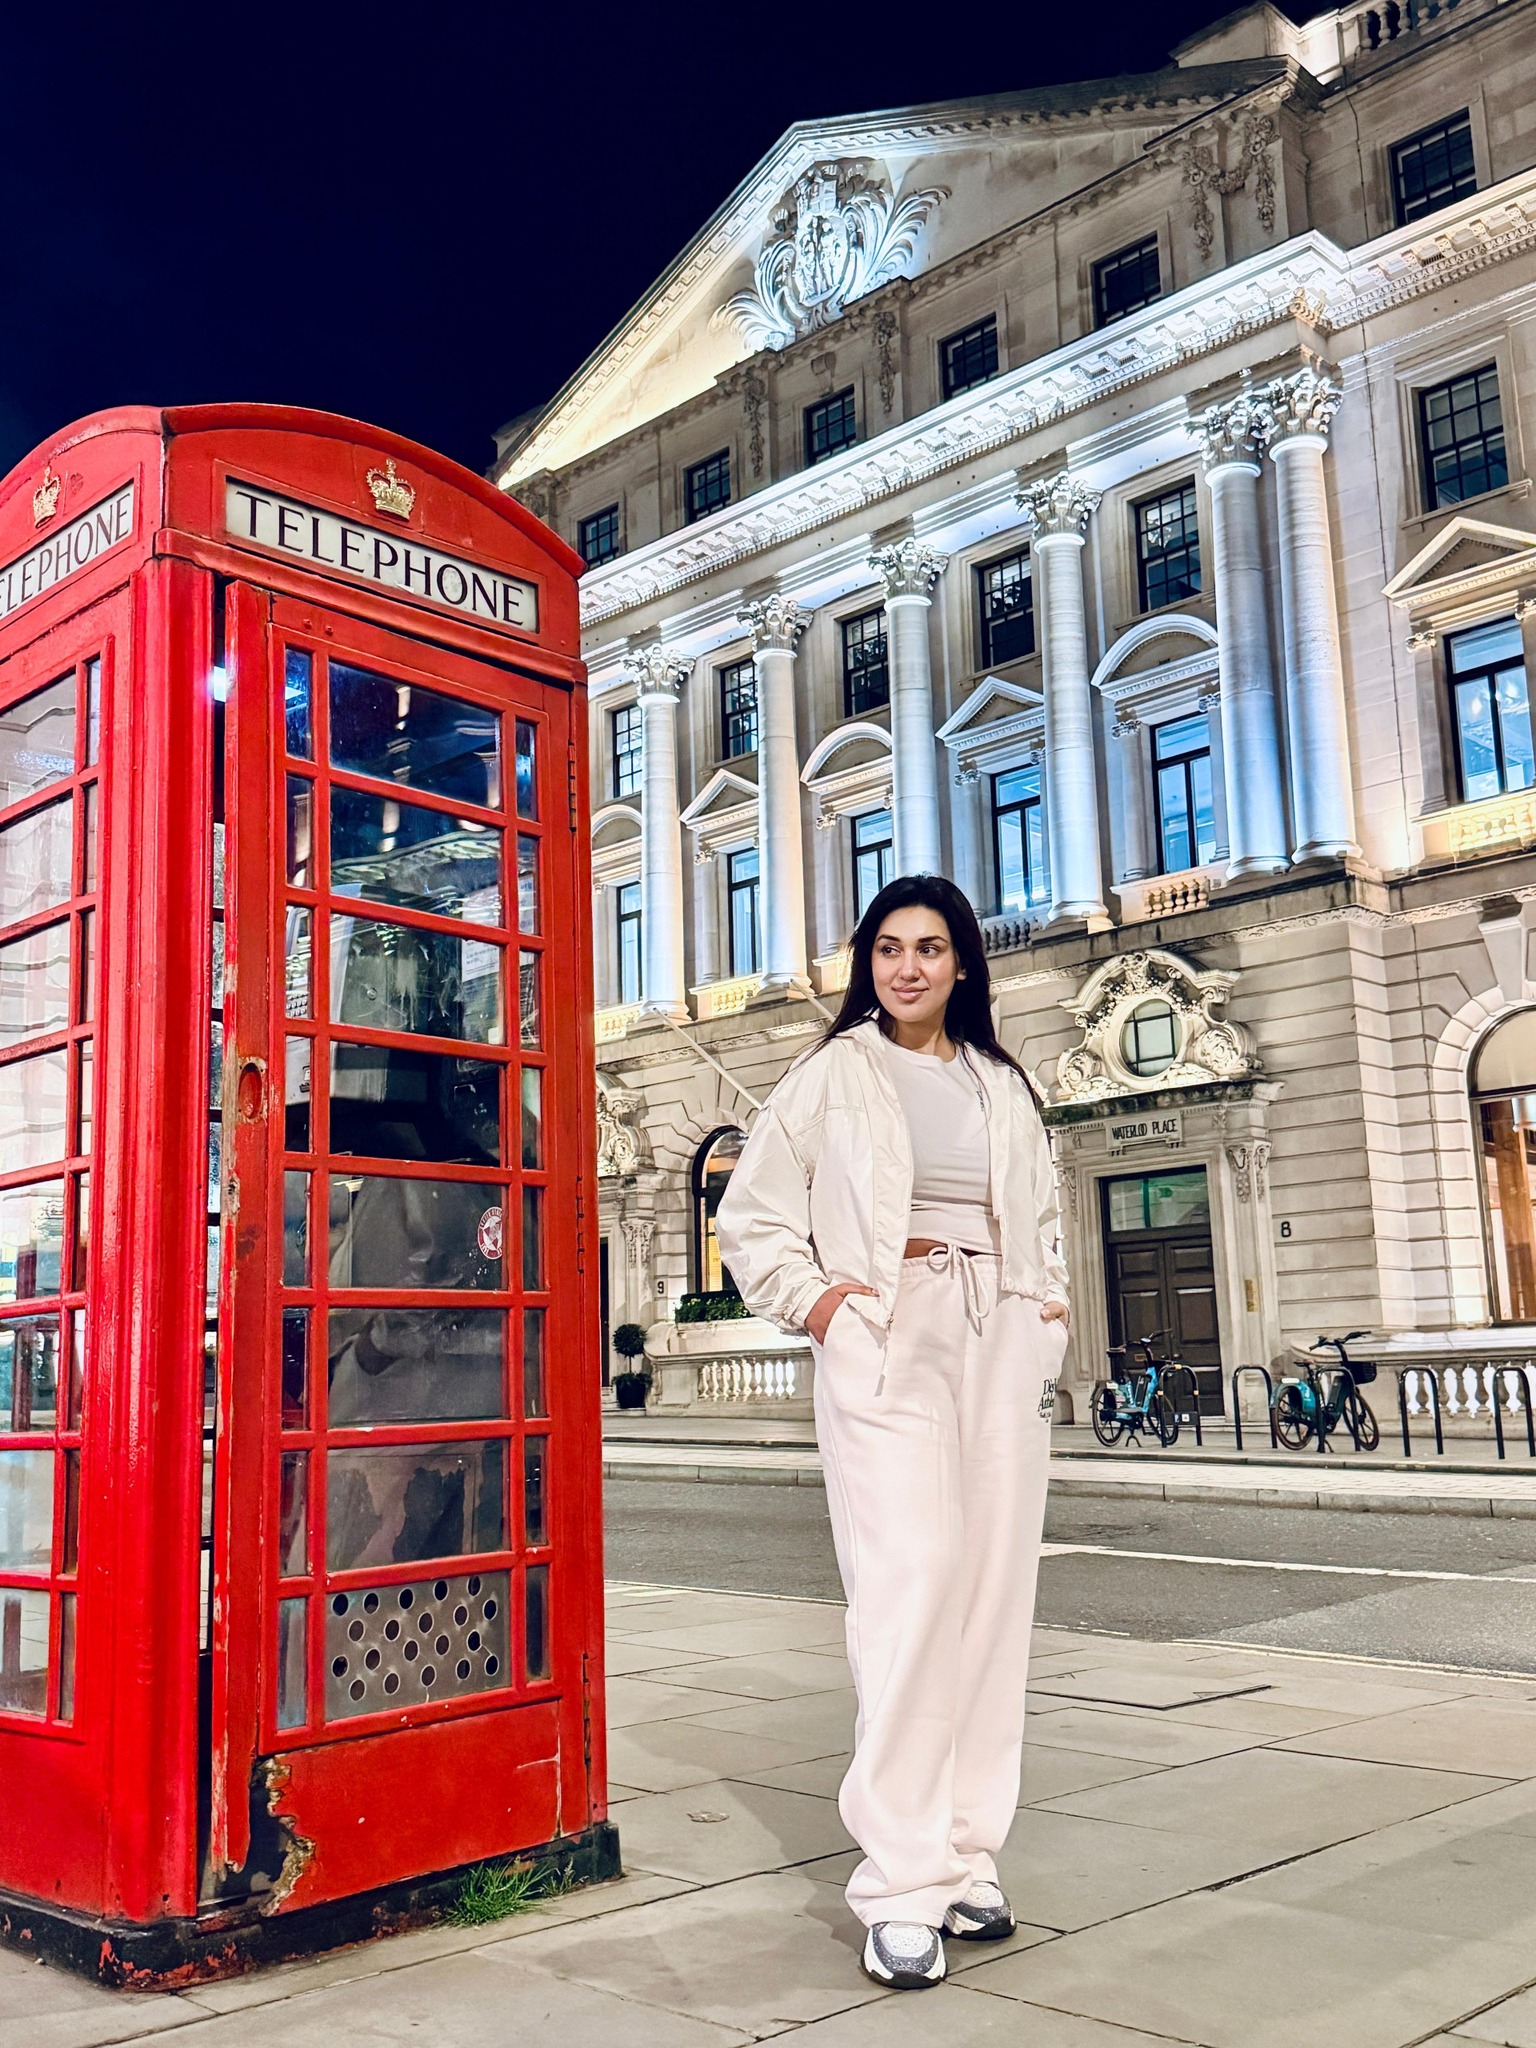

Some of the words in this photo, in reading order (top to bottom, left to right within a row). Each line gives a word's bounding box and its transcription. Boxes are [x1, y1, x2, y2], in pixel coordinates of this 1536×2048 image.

[236, 491, 523, 625] TELEPHONE
[1112, 1123, 1147, 1140] WATERLOO
[1152, 1119, 1177, 1135] PLACE
[1281, 1221, 1291, 1238] 8
[657, 1281, 664, 1294] 9
